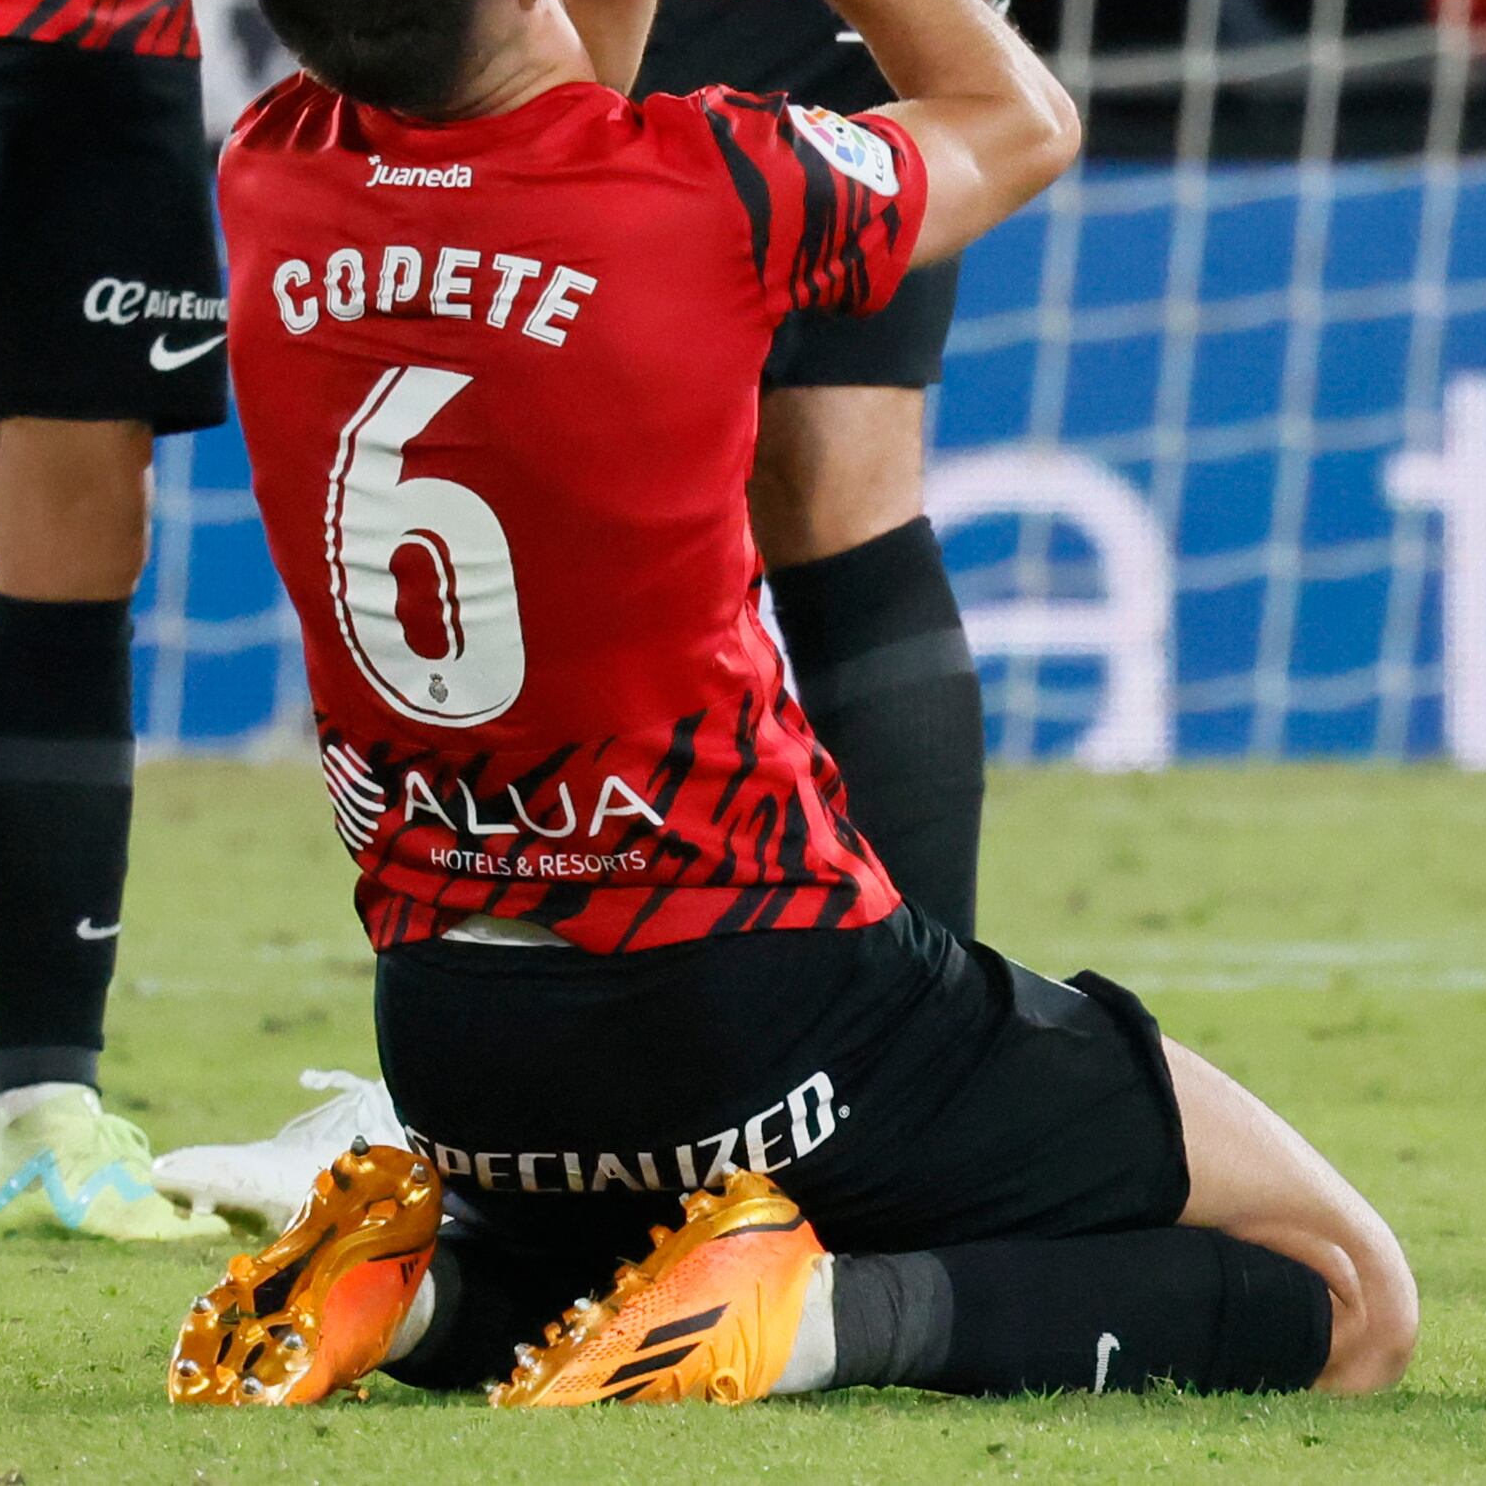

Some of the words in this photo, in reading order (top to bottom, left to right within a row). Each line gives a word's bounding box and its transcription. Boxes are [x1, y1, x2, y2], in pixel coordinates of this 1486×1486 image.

[365, 154, 473, 189] juaneda
[273, 244, 598, 348] COPETE
[324, 365, 526, 729] 6
[404, 770, 665, 839] ALUA
[430, 847, 512, 876] HOTELS
[516, 855, 535, 877] &
[539, 850, 647, 877] RESORTS
